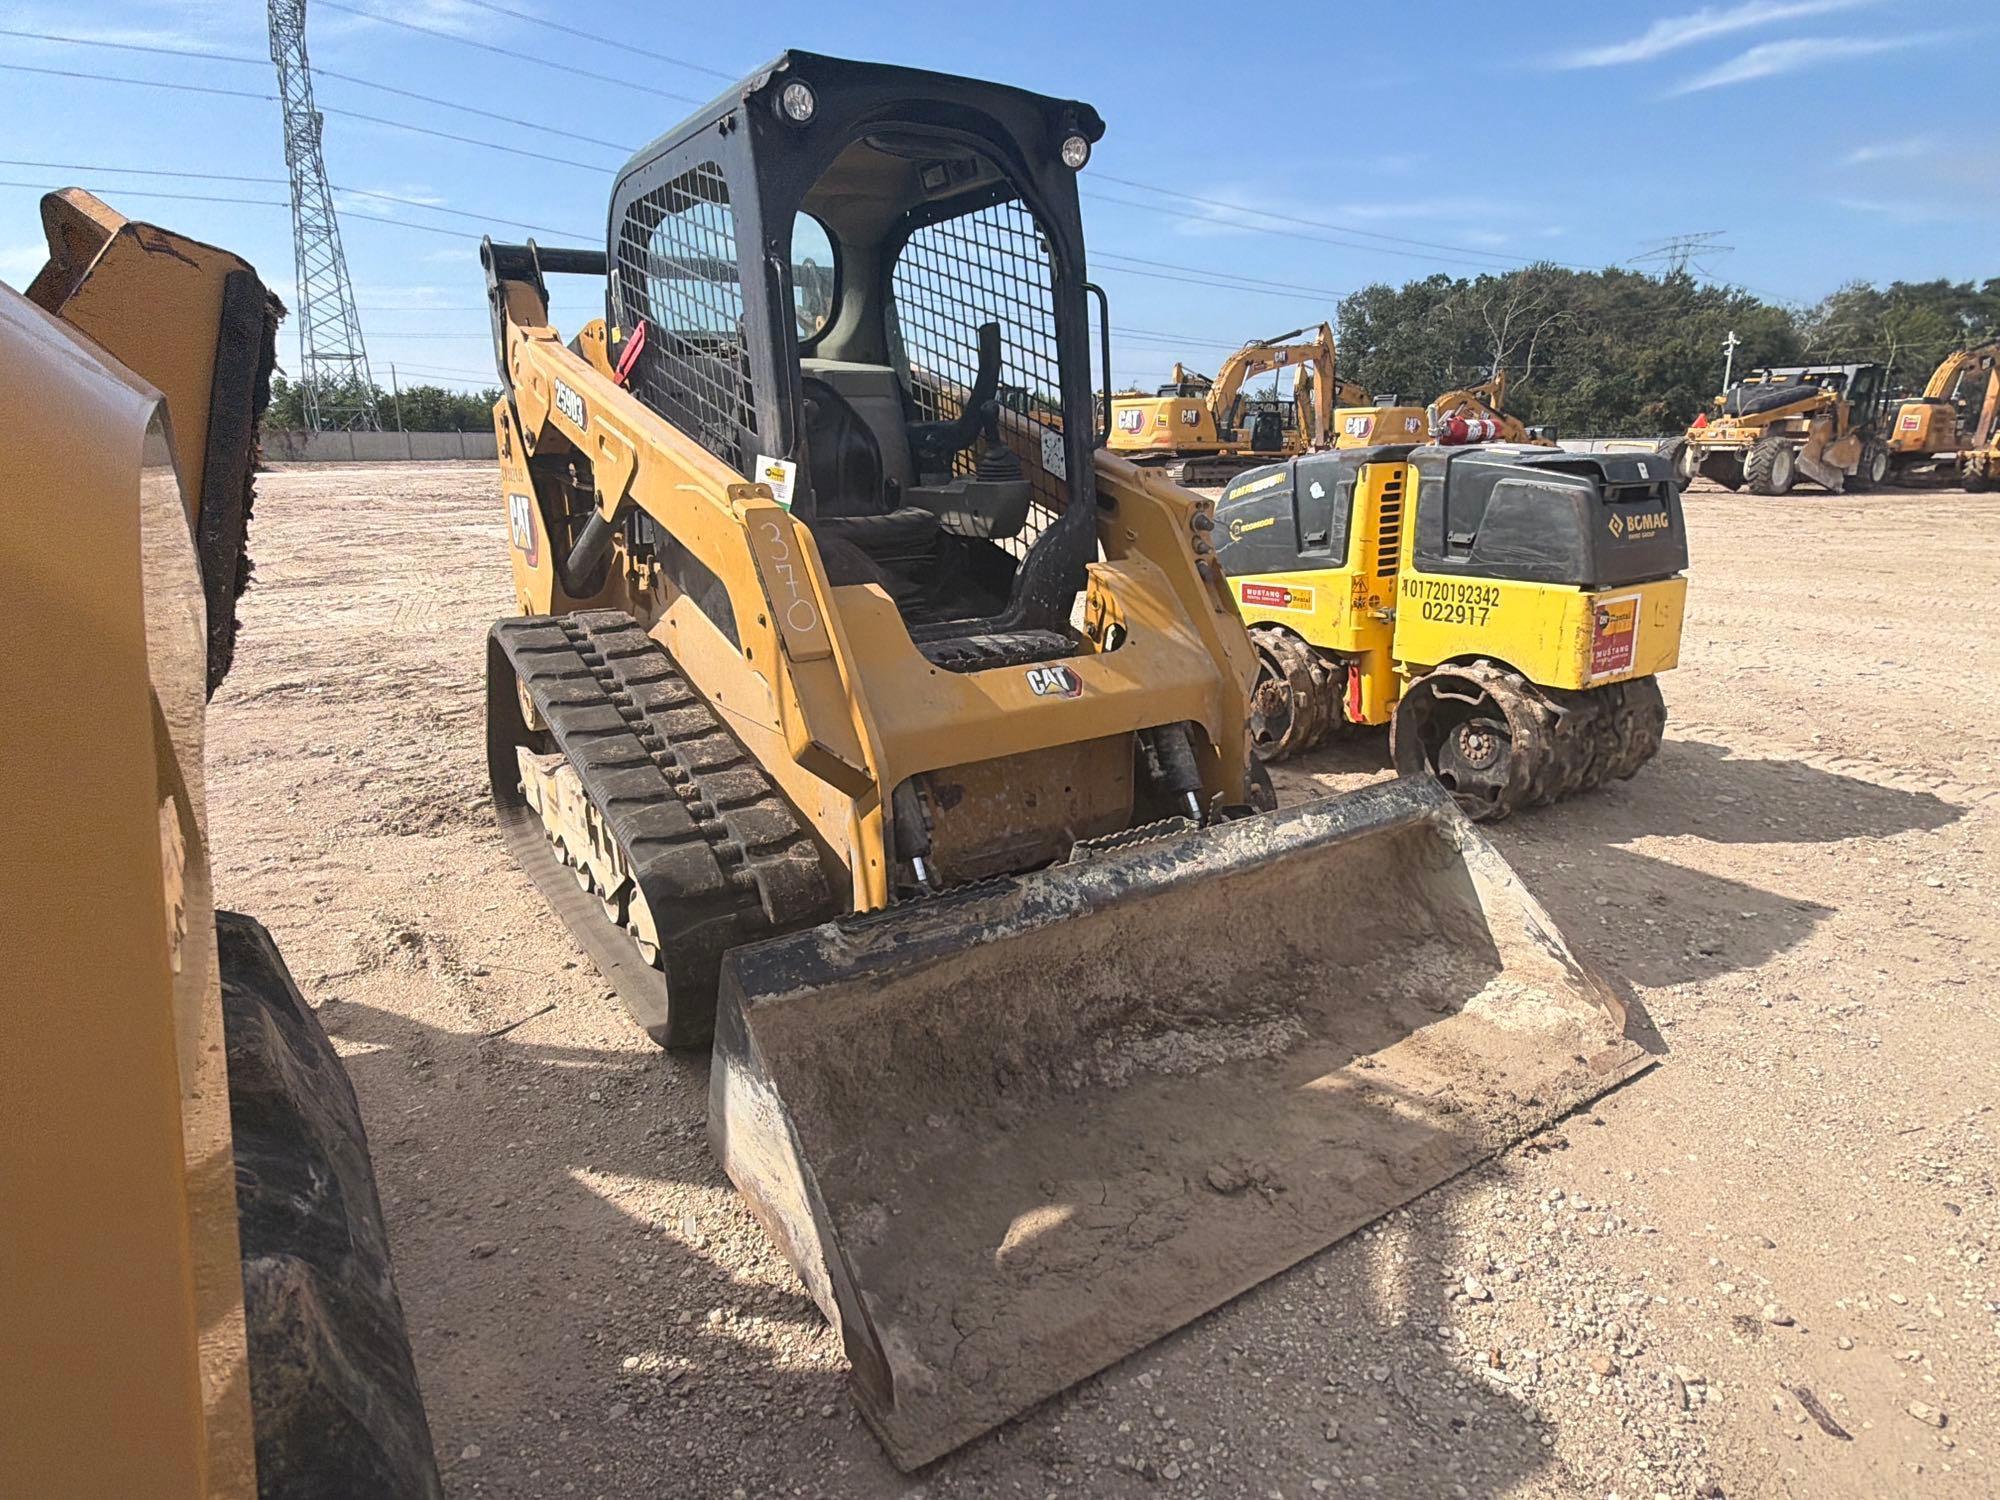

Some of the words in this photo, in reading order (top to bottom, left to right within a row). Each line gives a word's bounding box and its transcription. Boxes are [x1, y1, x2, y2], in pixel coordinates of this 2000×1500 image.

[554, 378, 584, 429] 259D3
[1118, 410, 1141, 430] CAT
[1181, 409, 1197, 424] CAT
[1345, 416, 1367, 435] CAT
[508, 494, 533, 551] CAT
[1246, 588, 1280, 598] MUSTANG
[1423, 602, 1489, 626] 022917
[1596, 644, 1629, 658] MUSTANG
[1026, 666, 1070, 695] CAT
